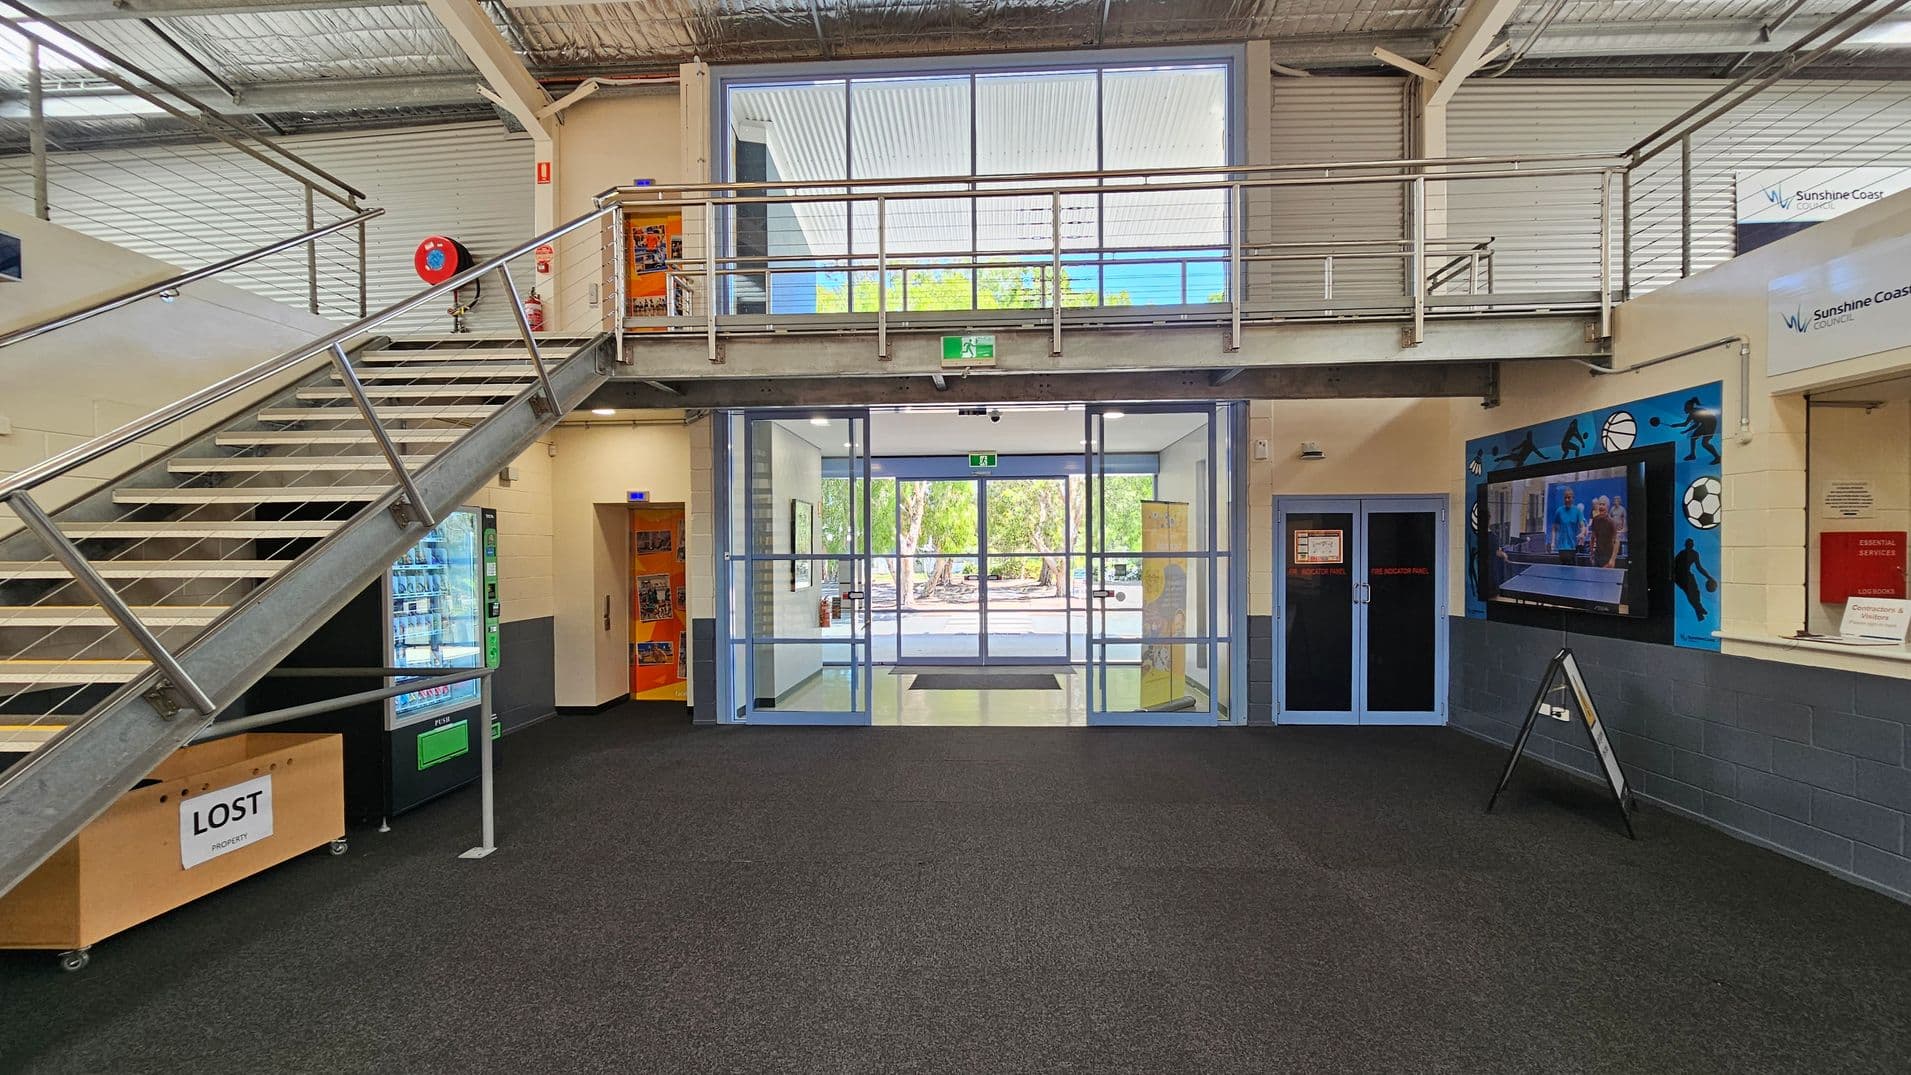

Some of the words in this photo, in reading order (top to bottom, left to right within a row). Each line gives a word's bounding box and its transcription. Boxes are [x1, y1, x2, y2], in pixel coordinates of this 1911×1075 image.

[1796, 190, 1849, 201] Sunshine
[1852, 189, 1884, 200] Coast
[1796, 202, 1835, 210] COUNCIL
[1813, 297, 1872, 321] Sunshine
[1813, 313, 1855, 330] COUNCIL
[1851, 604, 1895, 613] Contractors
[1861, 612, 1889, 621] Visitors
[434, 715, 450, 726] PUSH
[193, 790, 263, 836] LOST
[211, 832, 248, 852] PROPERTY
